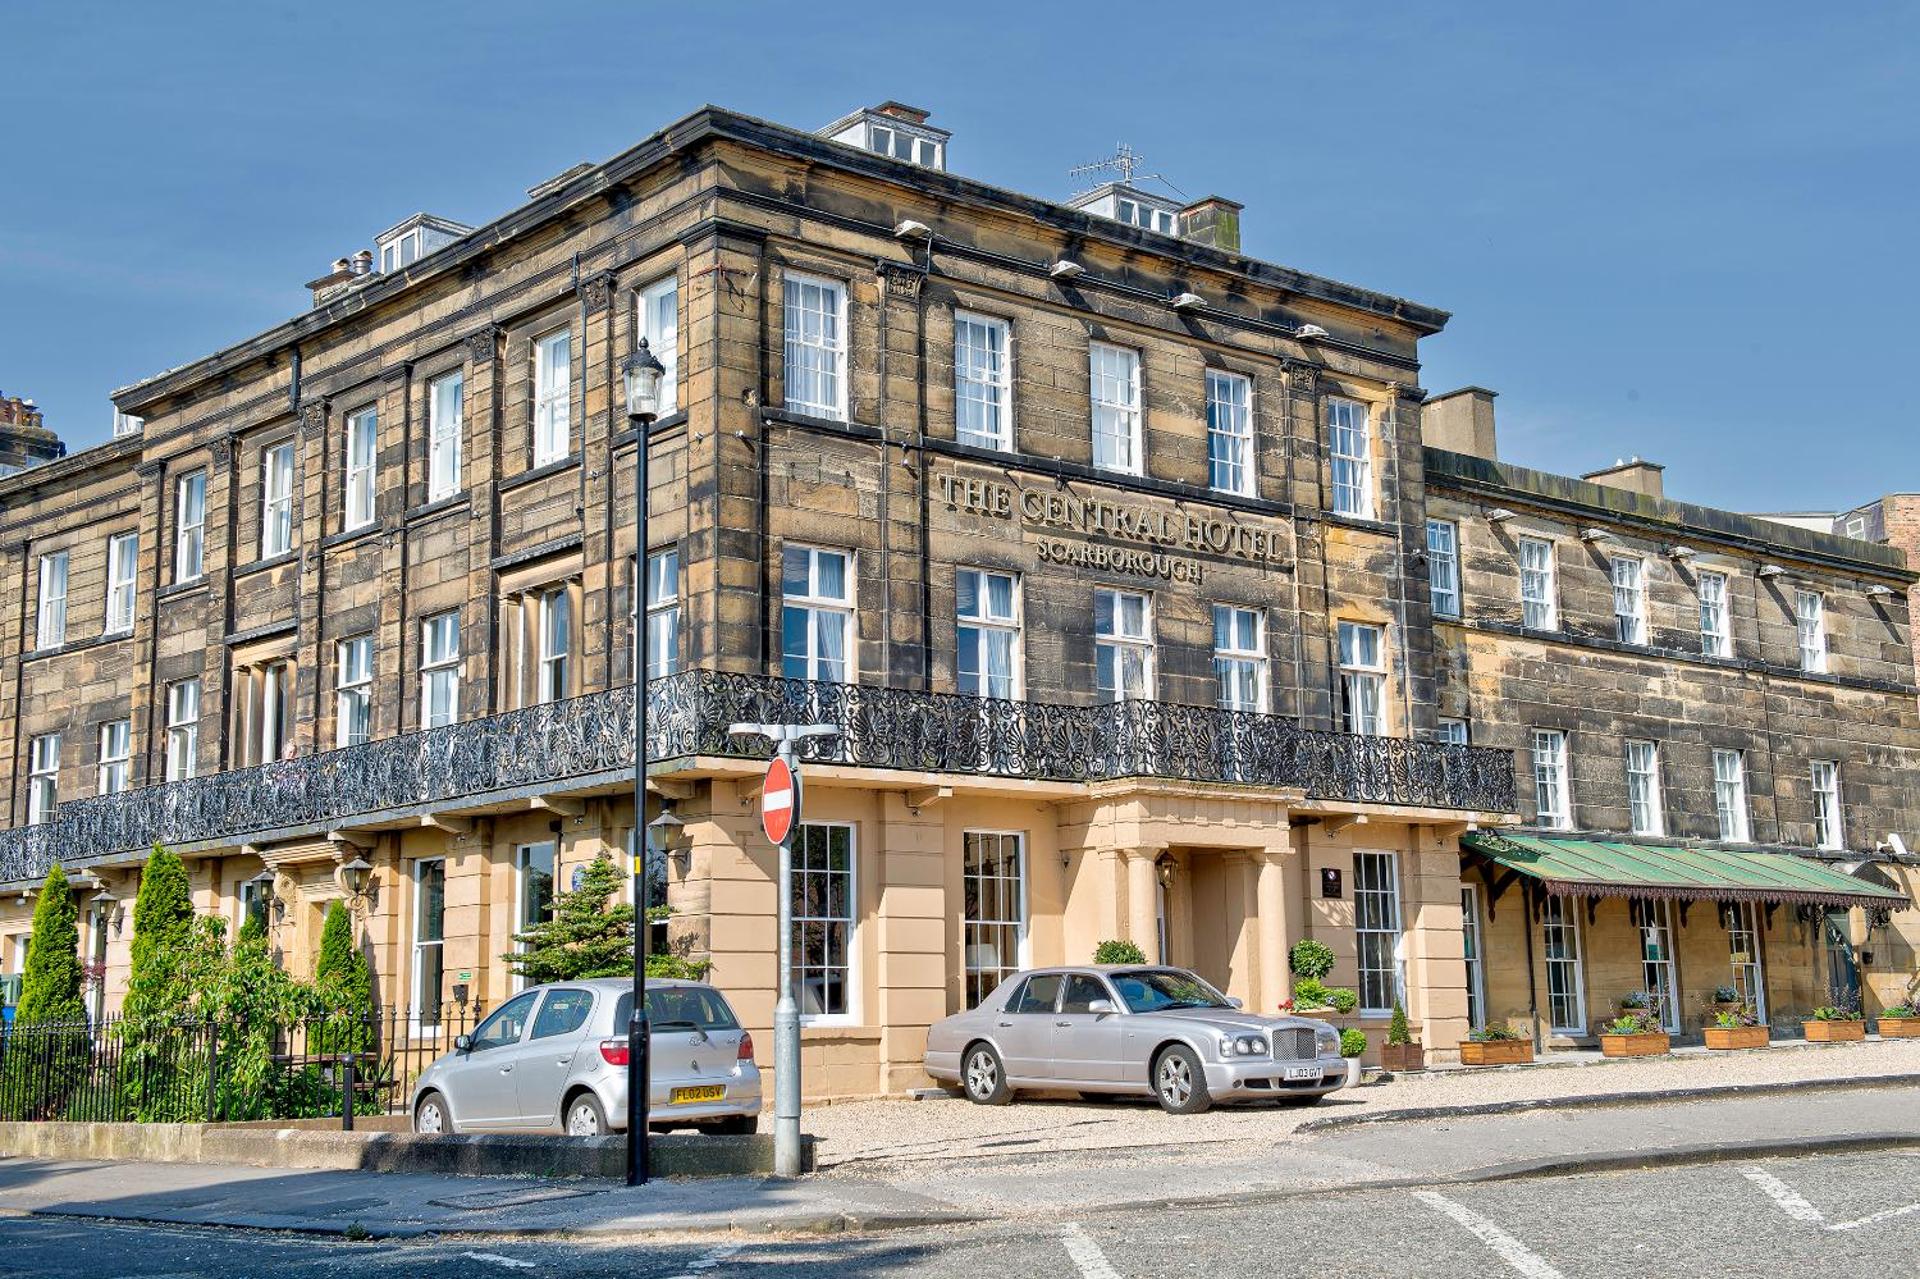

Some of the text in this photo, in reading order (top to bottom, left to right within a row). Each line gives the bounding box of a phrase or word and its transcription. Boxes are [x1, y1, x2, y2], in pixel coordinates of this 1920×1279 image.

[936, 473, 1284, 560] THE CENTRAL HOTEL
[1036, 534, 1200, 581] SCARBOROUGH
